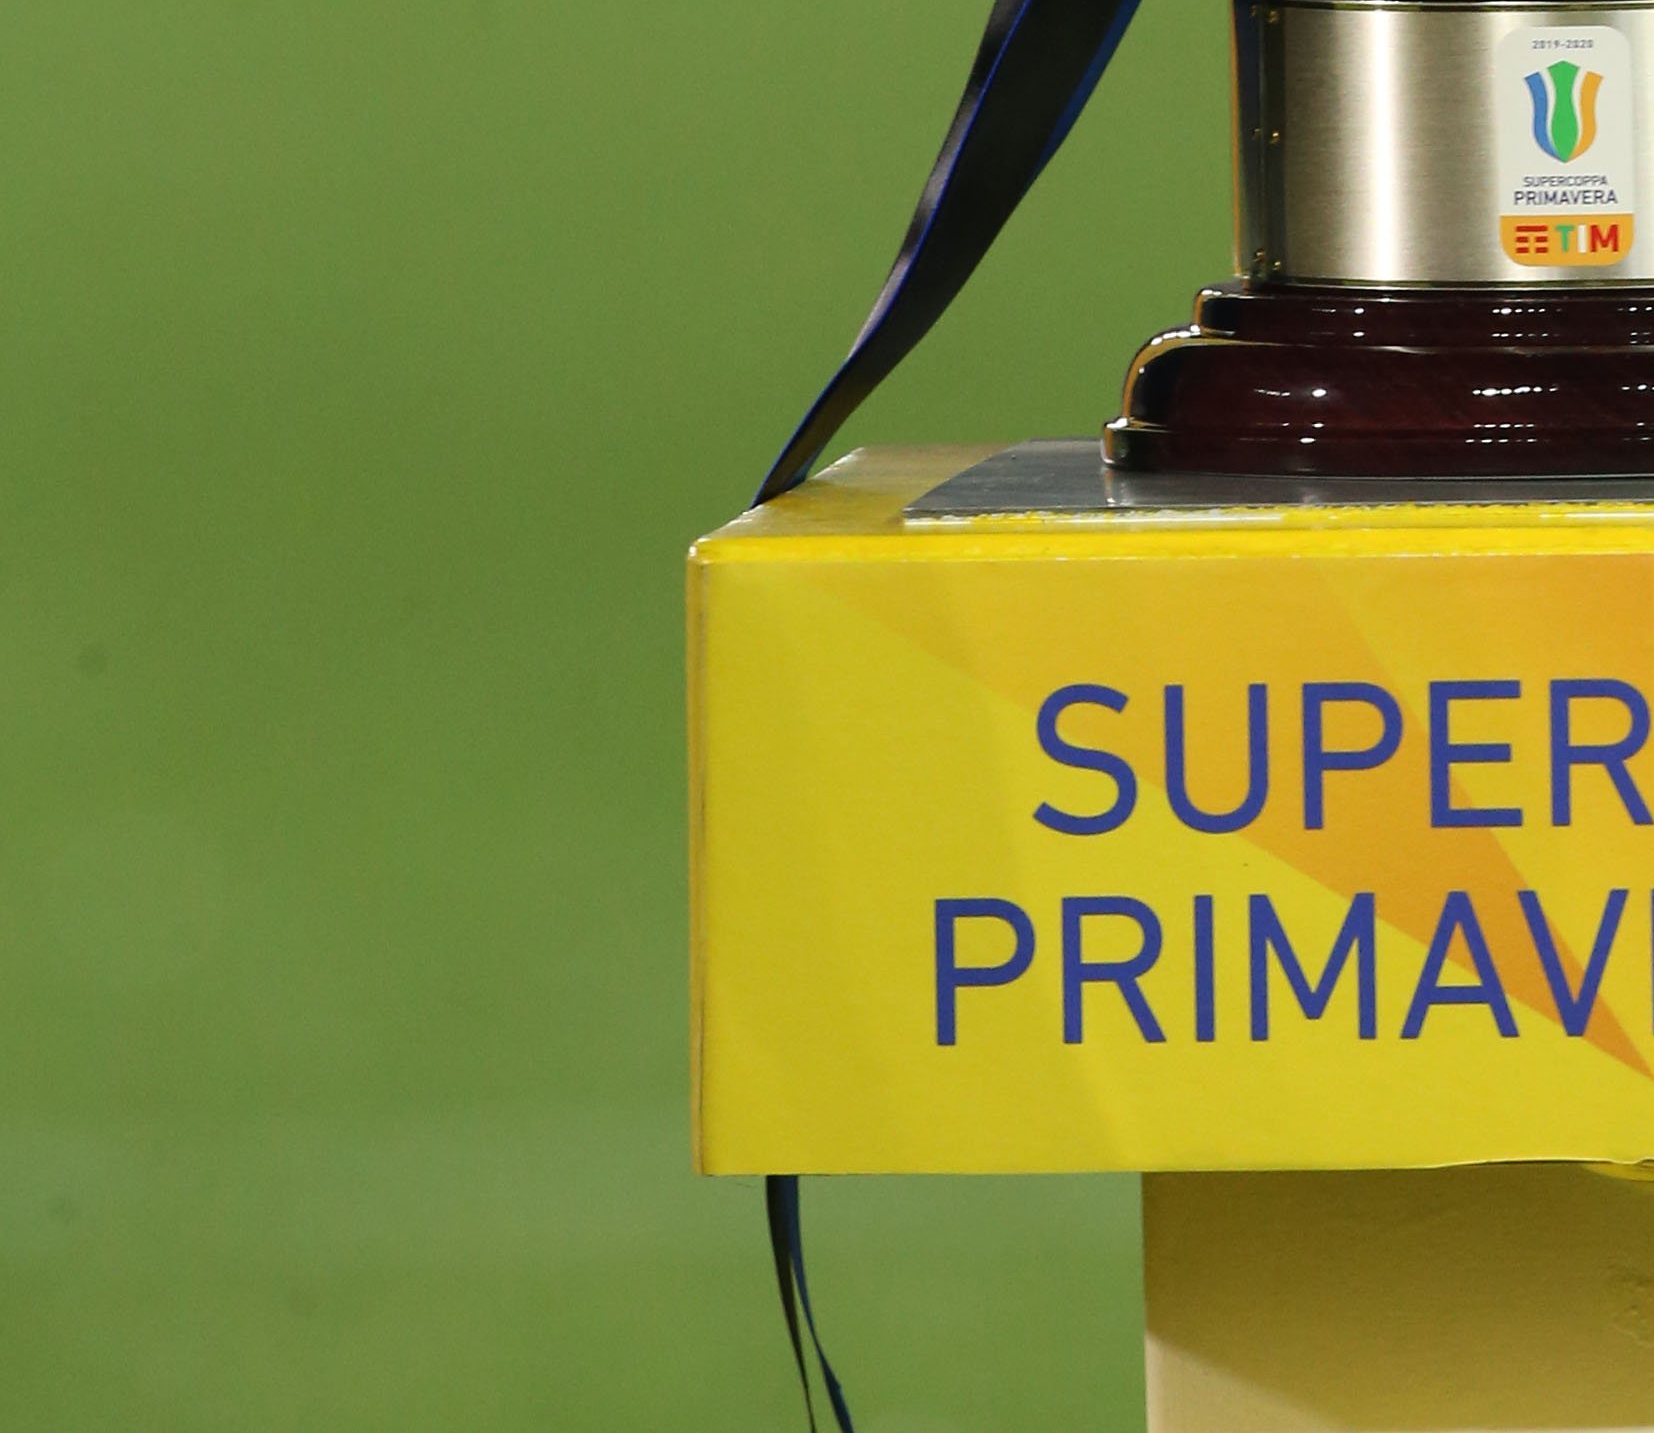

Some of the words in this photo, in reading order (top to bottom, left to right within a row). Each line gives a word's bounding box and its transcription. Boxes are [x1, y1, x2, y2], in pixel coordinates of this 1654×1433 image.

[1532, 39, 1594, 49] 2019-2020
[1523, 175, 1608, 187] SUPERCOPPA
[1513, 189, 1618, 206] PRIMAVERA
[1555, 224, 1620, 254] TIM
